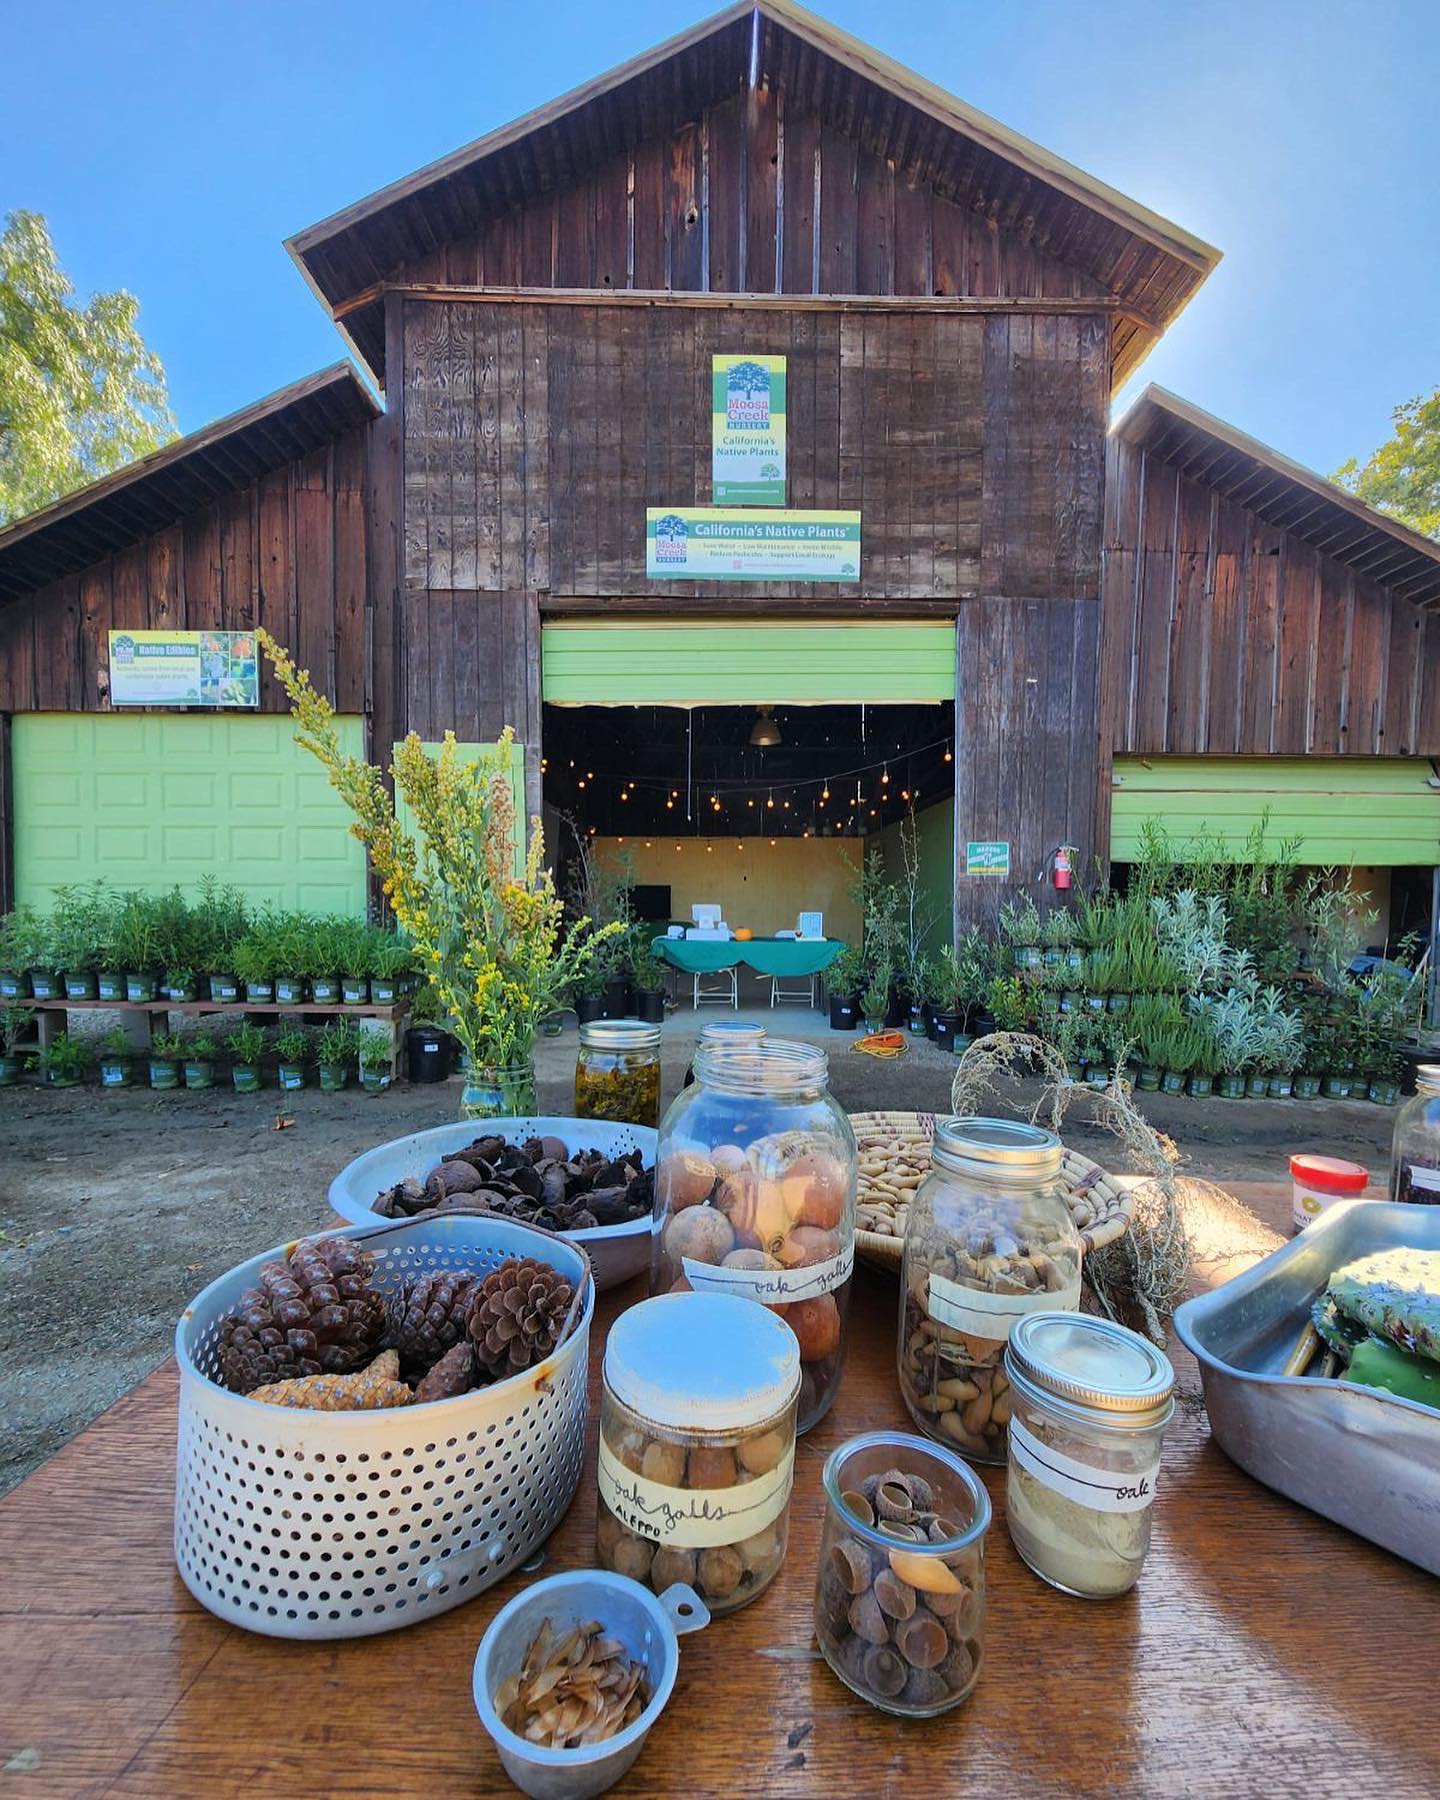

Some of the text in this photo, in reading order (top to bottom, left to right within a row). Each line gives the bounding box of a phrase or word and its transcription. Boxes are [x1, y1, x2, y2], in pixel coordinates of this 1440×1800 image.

[728, 399, 768, 410] Moosa
[728, 410, 768, 421] Creek
[722, 436, 776, 446] California's
[716, 447, 779, 457] Native Plants
[695, 523, 763, 537] California's
[765, 525, 805, 538] Native
[754, 1260, 850, 1295] oak galls
[1116, 1477, 1149, 1500] oak
[614, 1479, 727, 1531] oak galls
[615, 1504, 661, 1537] ALEPPO
